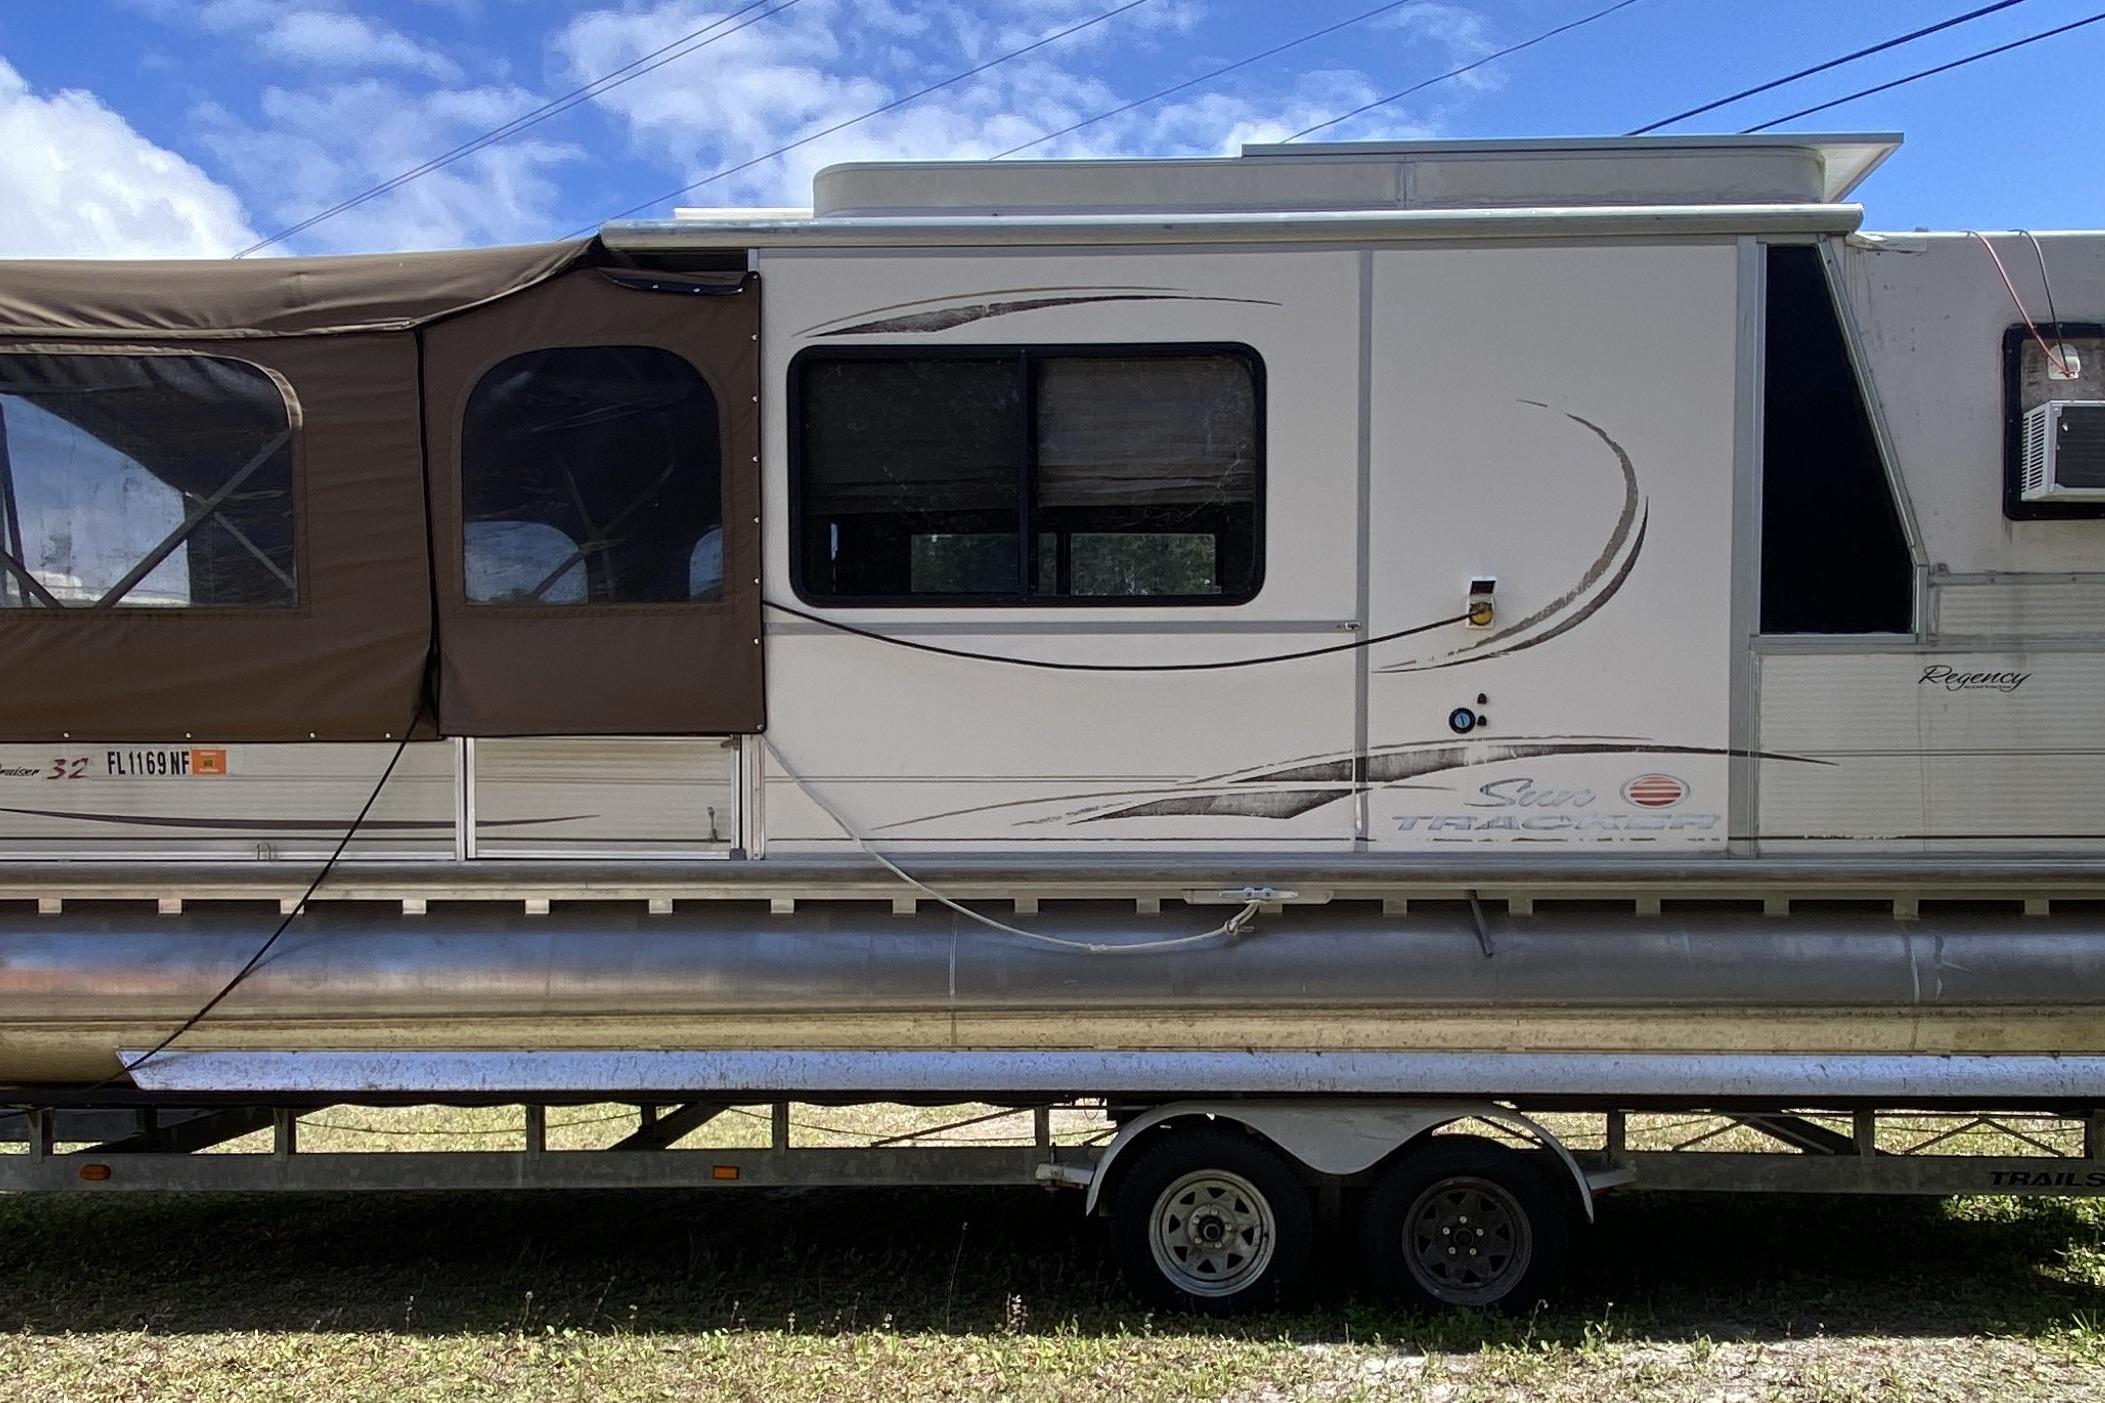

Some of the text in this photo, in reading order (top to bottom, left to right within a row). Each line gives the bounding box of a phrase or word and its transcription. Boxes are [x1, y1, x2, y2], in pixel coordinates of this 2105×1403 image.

[1918, 664, 2032, 692] Regency
[0, 757, 89, 780] ruiser 32
[1464, 778, 1596, 807] Sun
